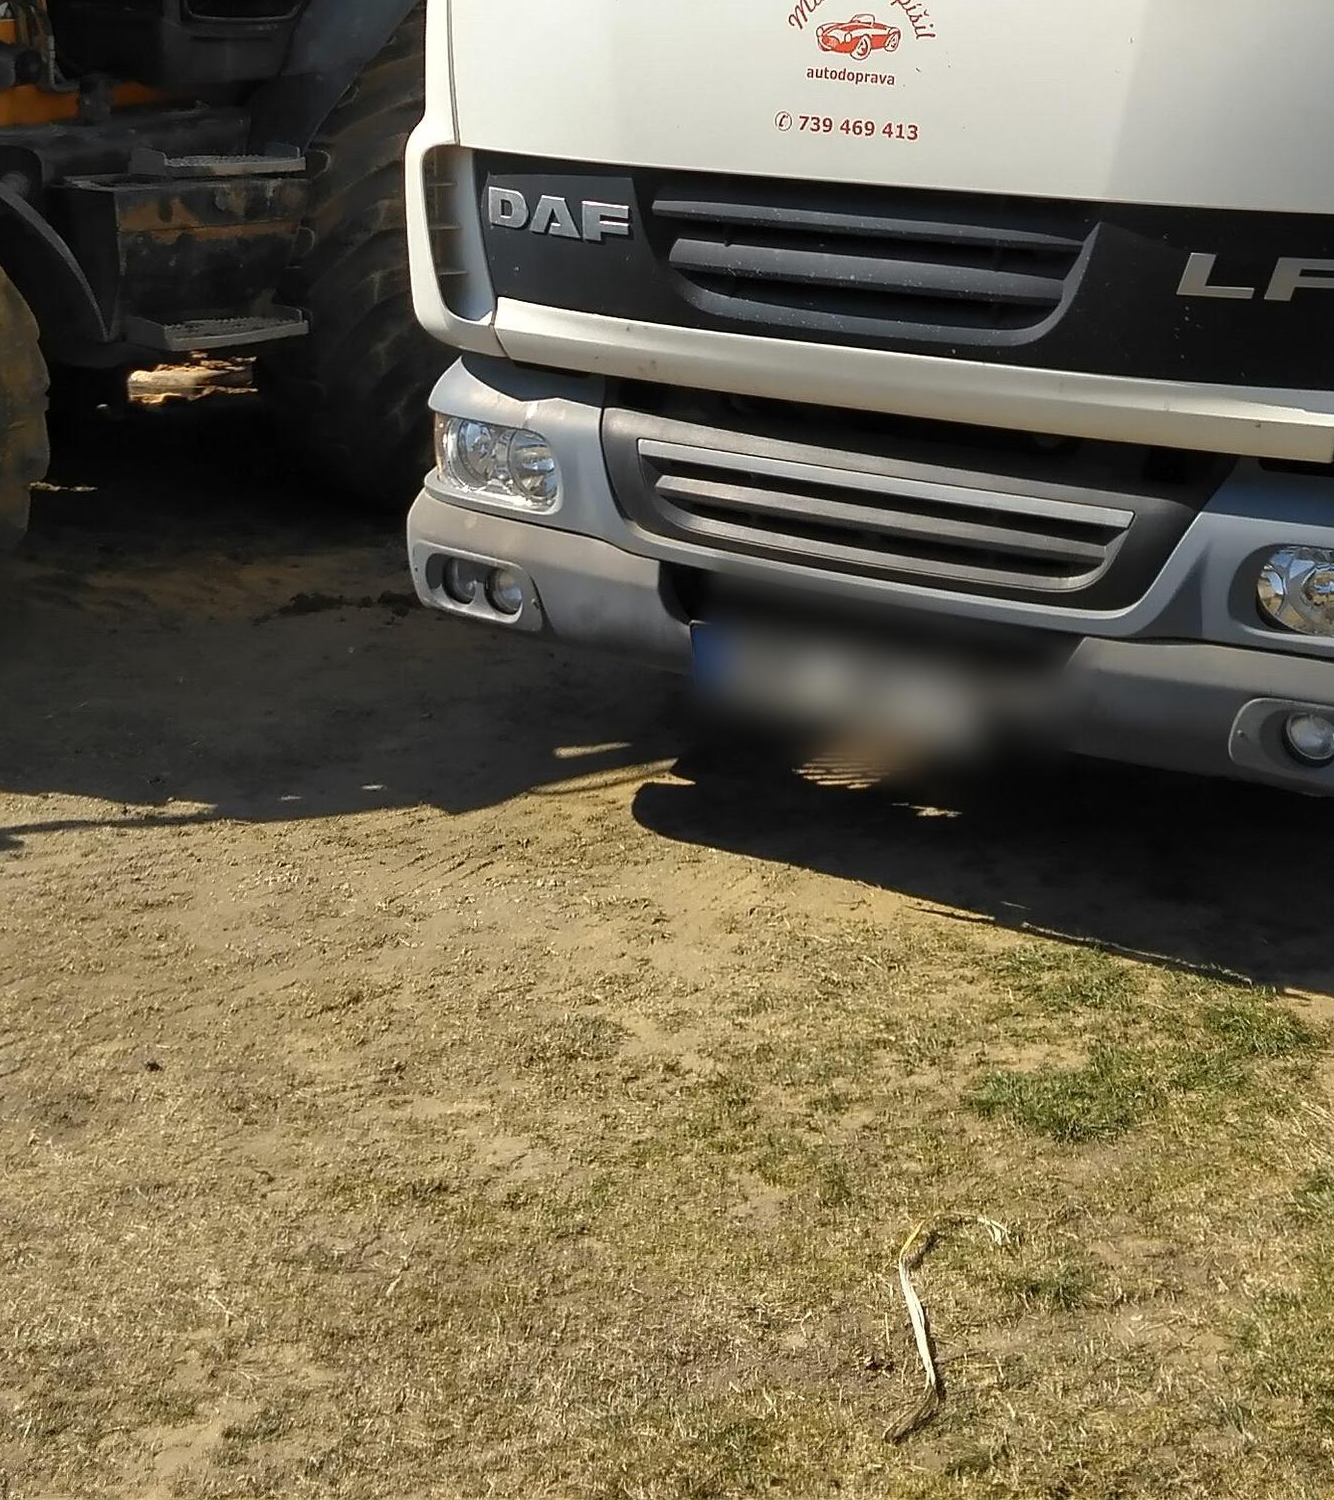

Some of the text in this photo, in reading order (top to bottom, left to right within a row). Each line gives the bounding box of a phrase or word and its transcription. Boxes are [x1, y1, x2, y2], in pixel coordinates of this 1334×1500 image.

[806, 67, 896, 85] autodoprava
[798, 115, 919, 141] 739 469 413
[488, 186, 630, 242] DAF
